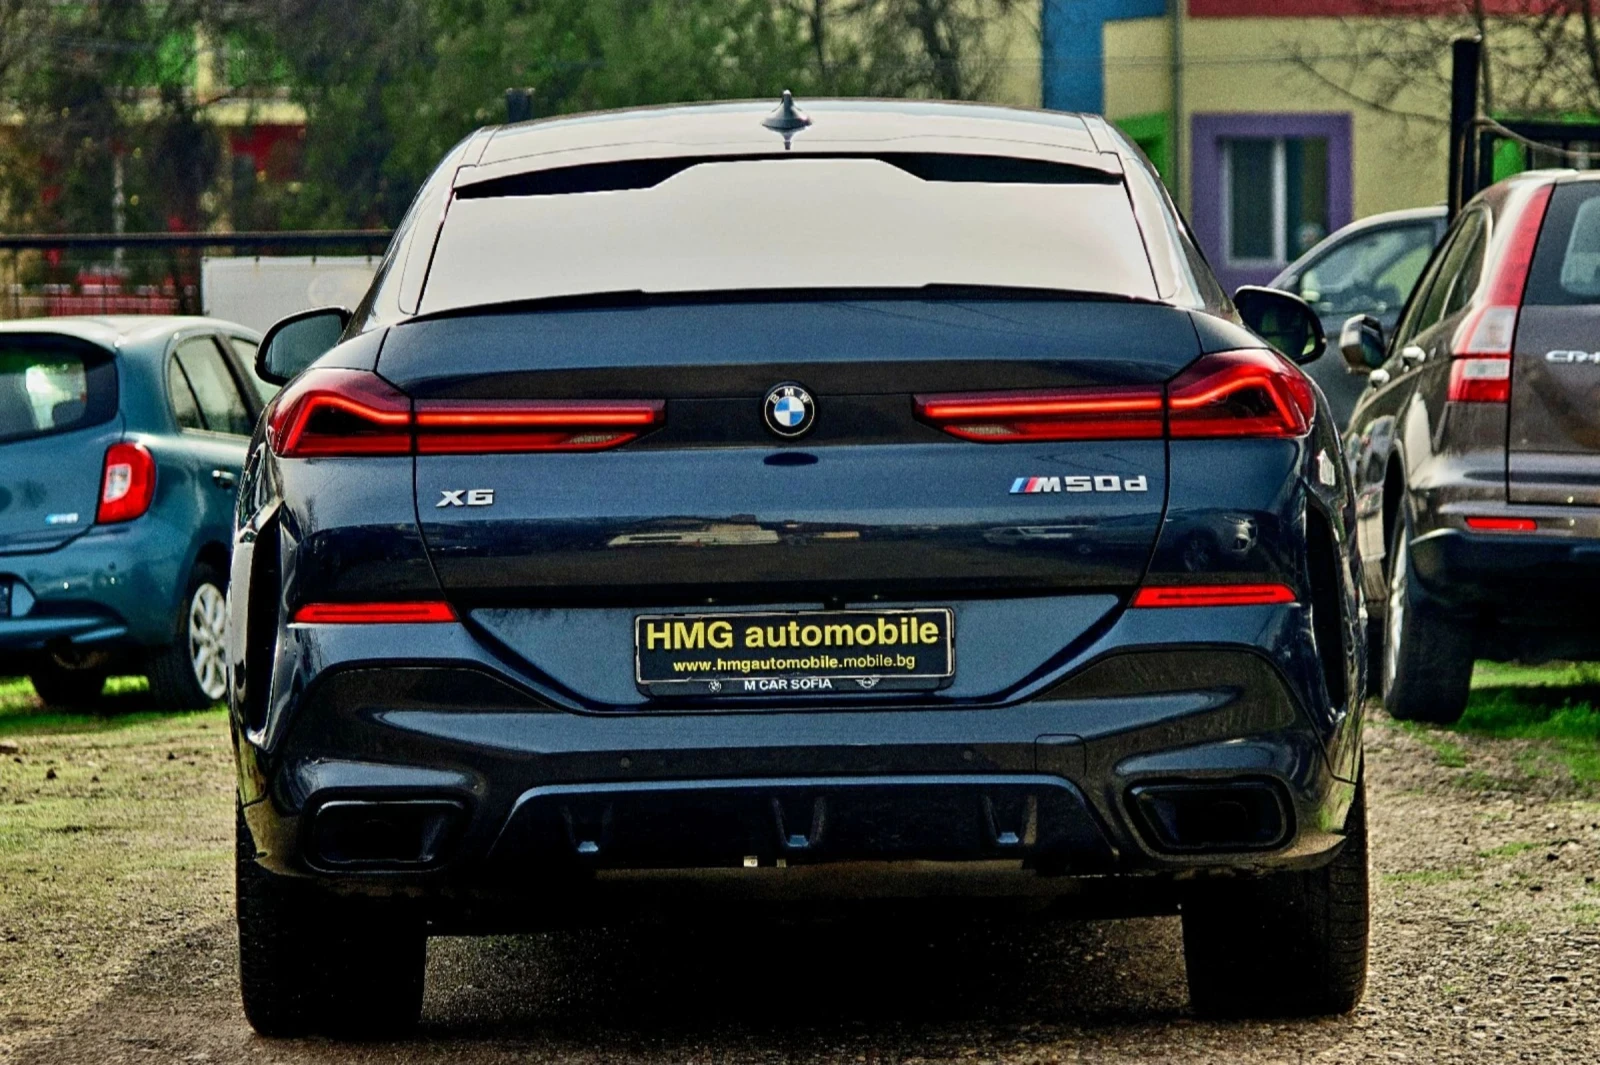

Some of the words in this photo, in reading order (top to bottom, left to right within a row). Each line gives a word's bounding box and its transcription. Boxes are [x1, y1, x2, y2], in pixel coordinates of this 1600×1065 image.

[1030, 475, 1148, 493] M50d
[435, 488, 494, 507] X6
[647, 620, 734, 650] HMG
[745, 617, 939, 648] automobile
[673, 654, 915, 672] www.hmgautomobile.mobile.bg
[744, 681, 756, 690] M
[759, 680, 788, 690] CAR
[790, 678, 832, 690] SOFIA
